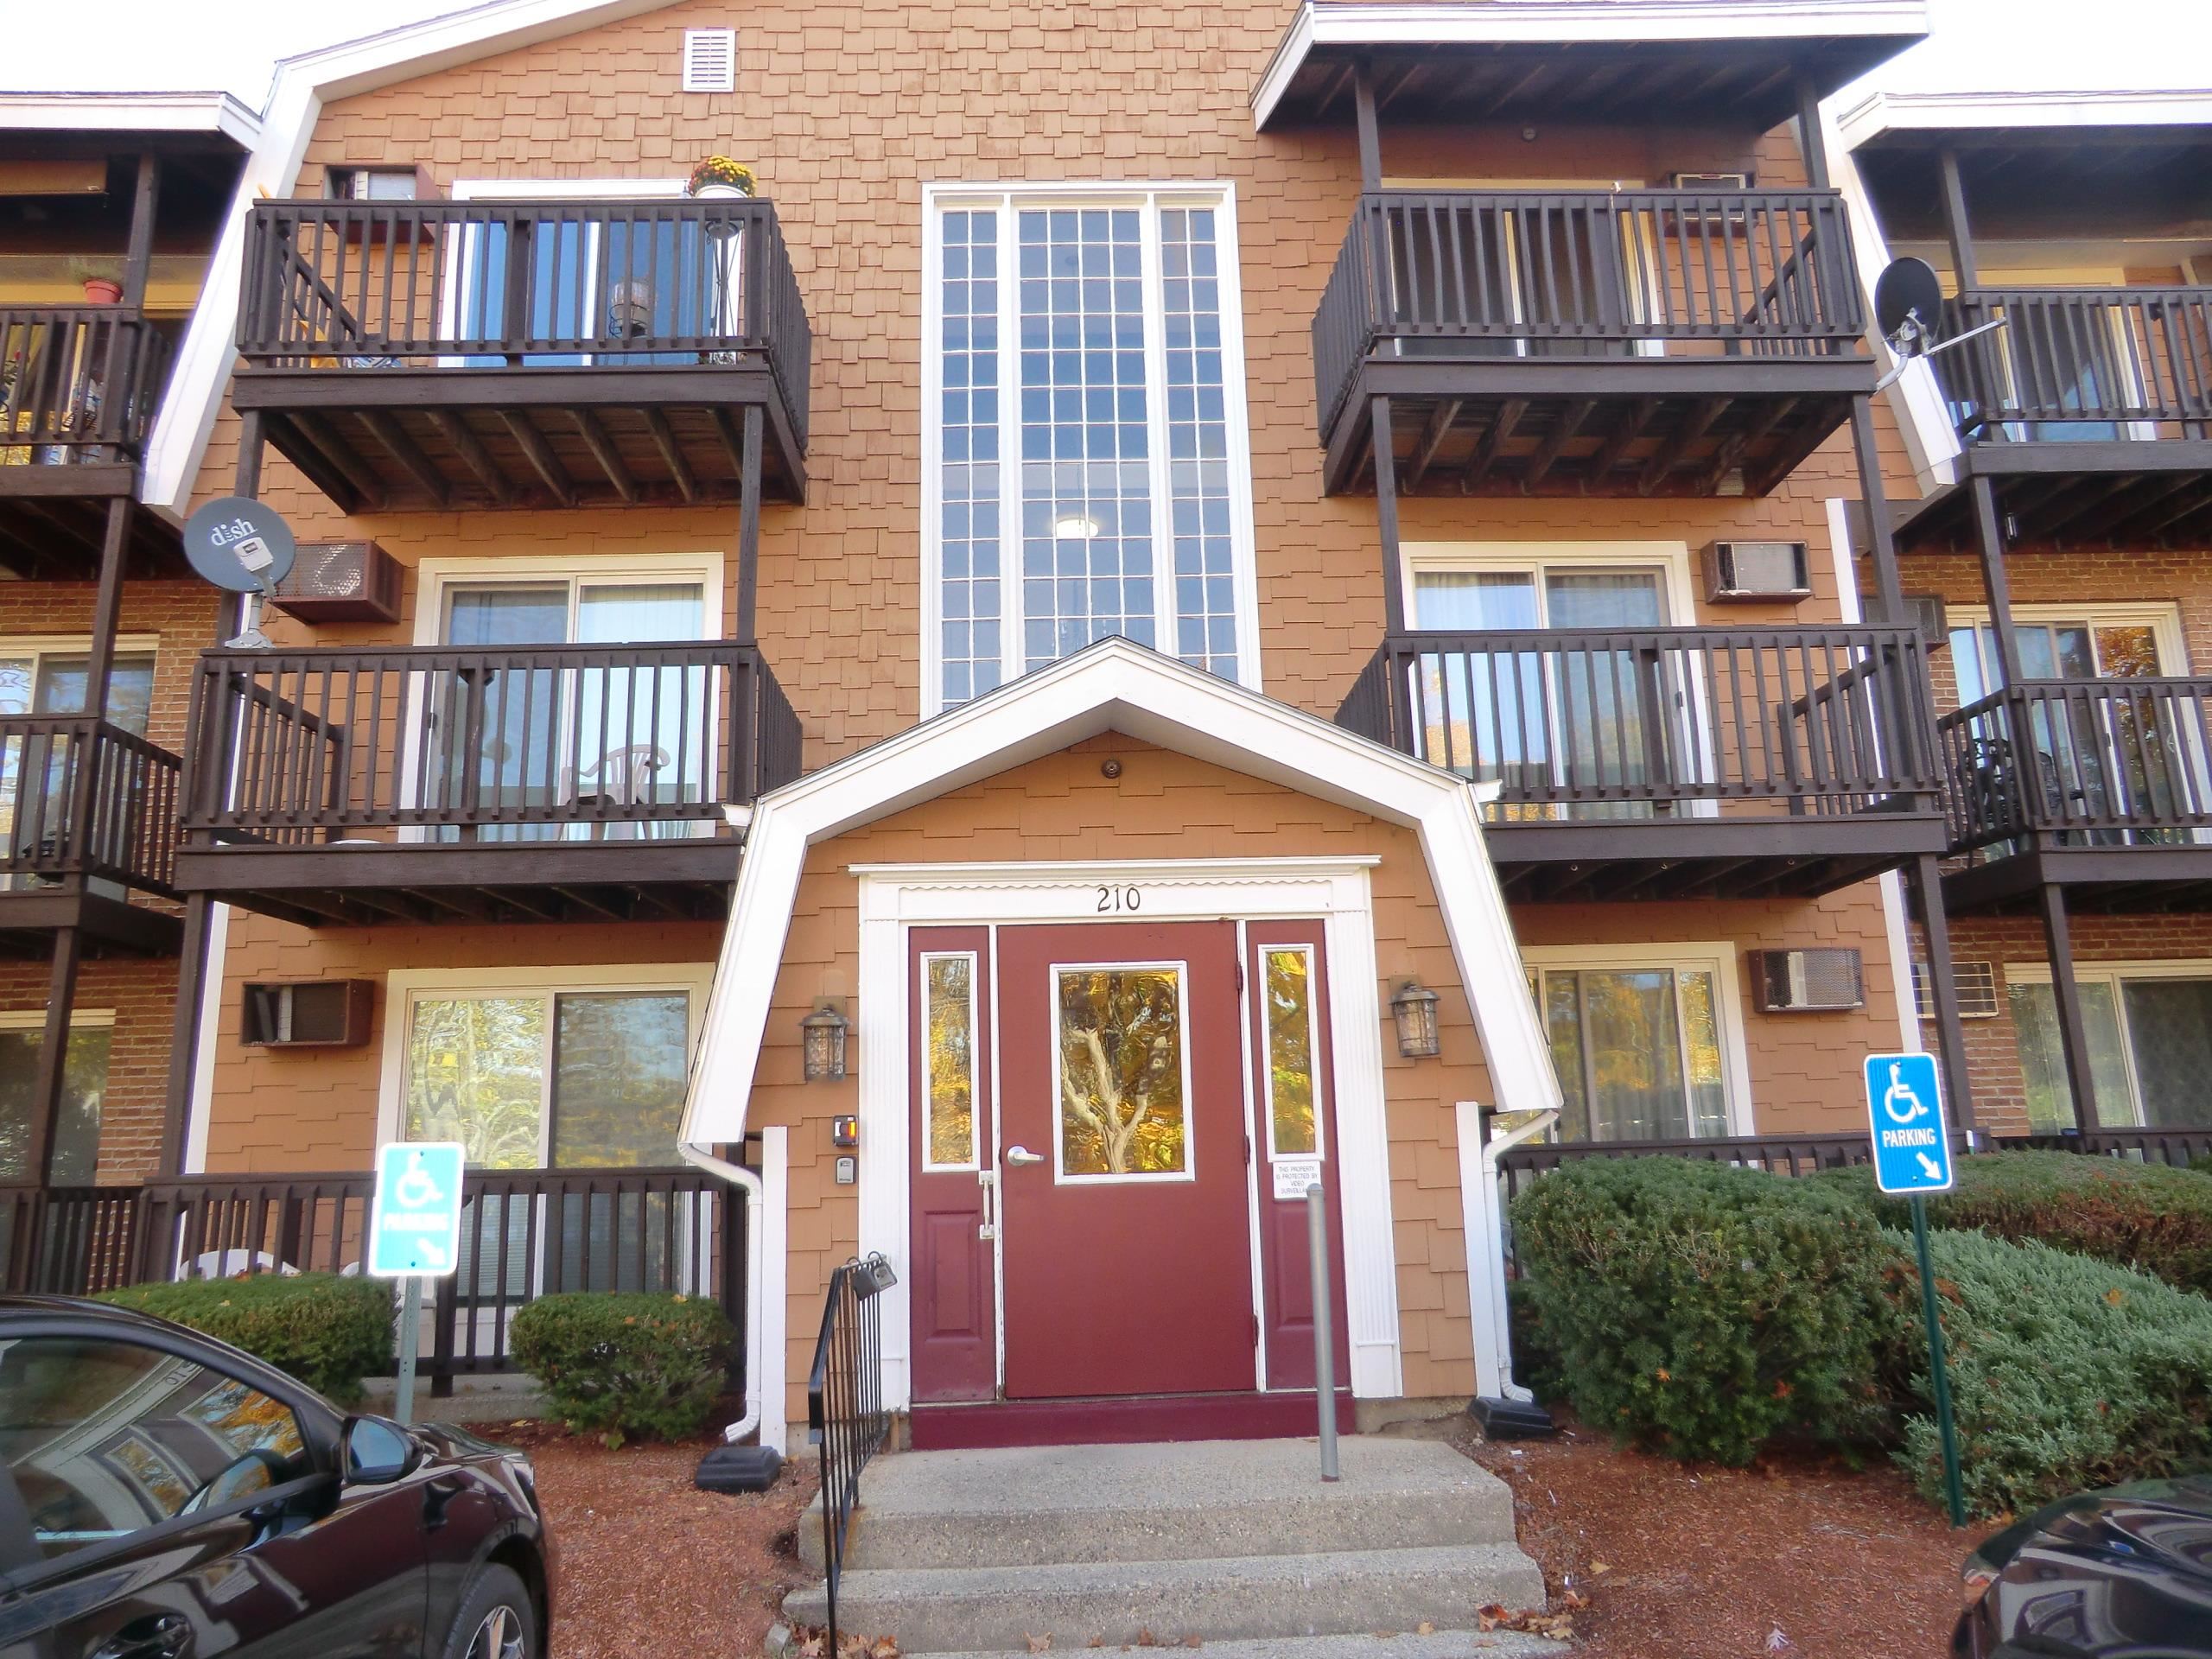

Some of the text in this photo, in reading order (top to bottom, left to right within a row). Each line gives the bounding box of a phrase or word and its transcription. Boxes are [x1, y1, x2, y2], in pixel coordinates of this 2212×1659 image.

[211, 518, 257, 546] dish
[1097, 887, 1141, 912] 210
[1882, 1128, 1936, 1148] PARKING
